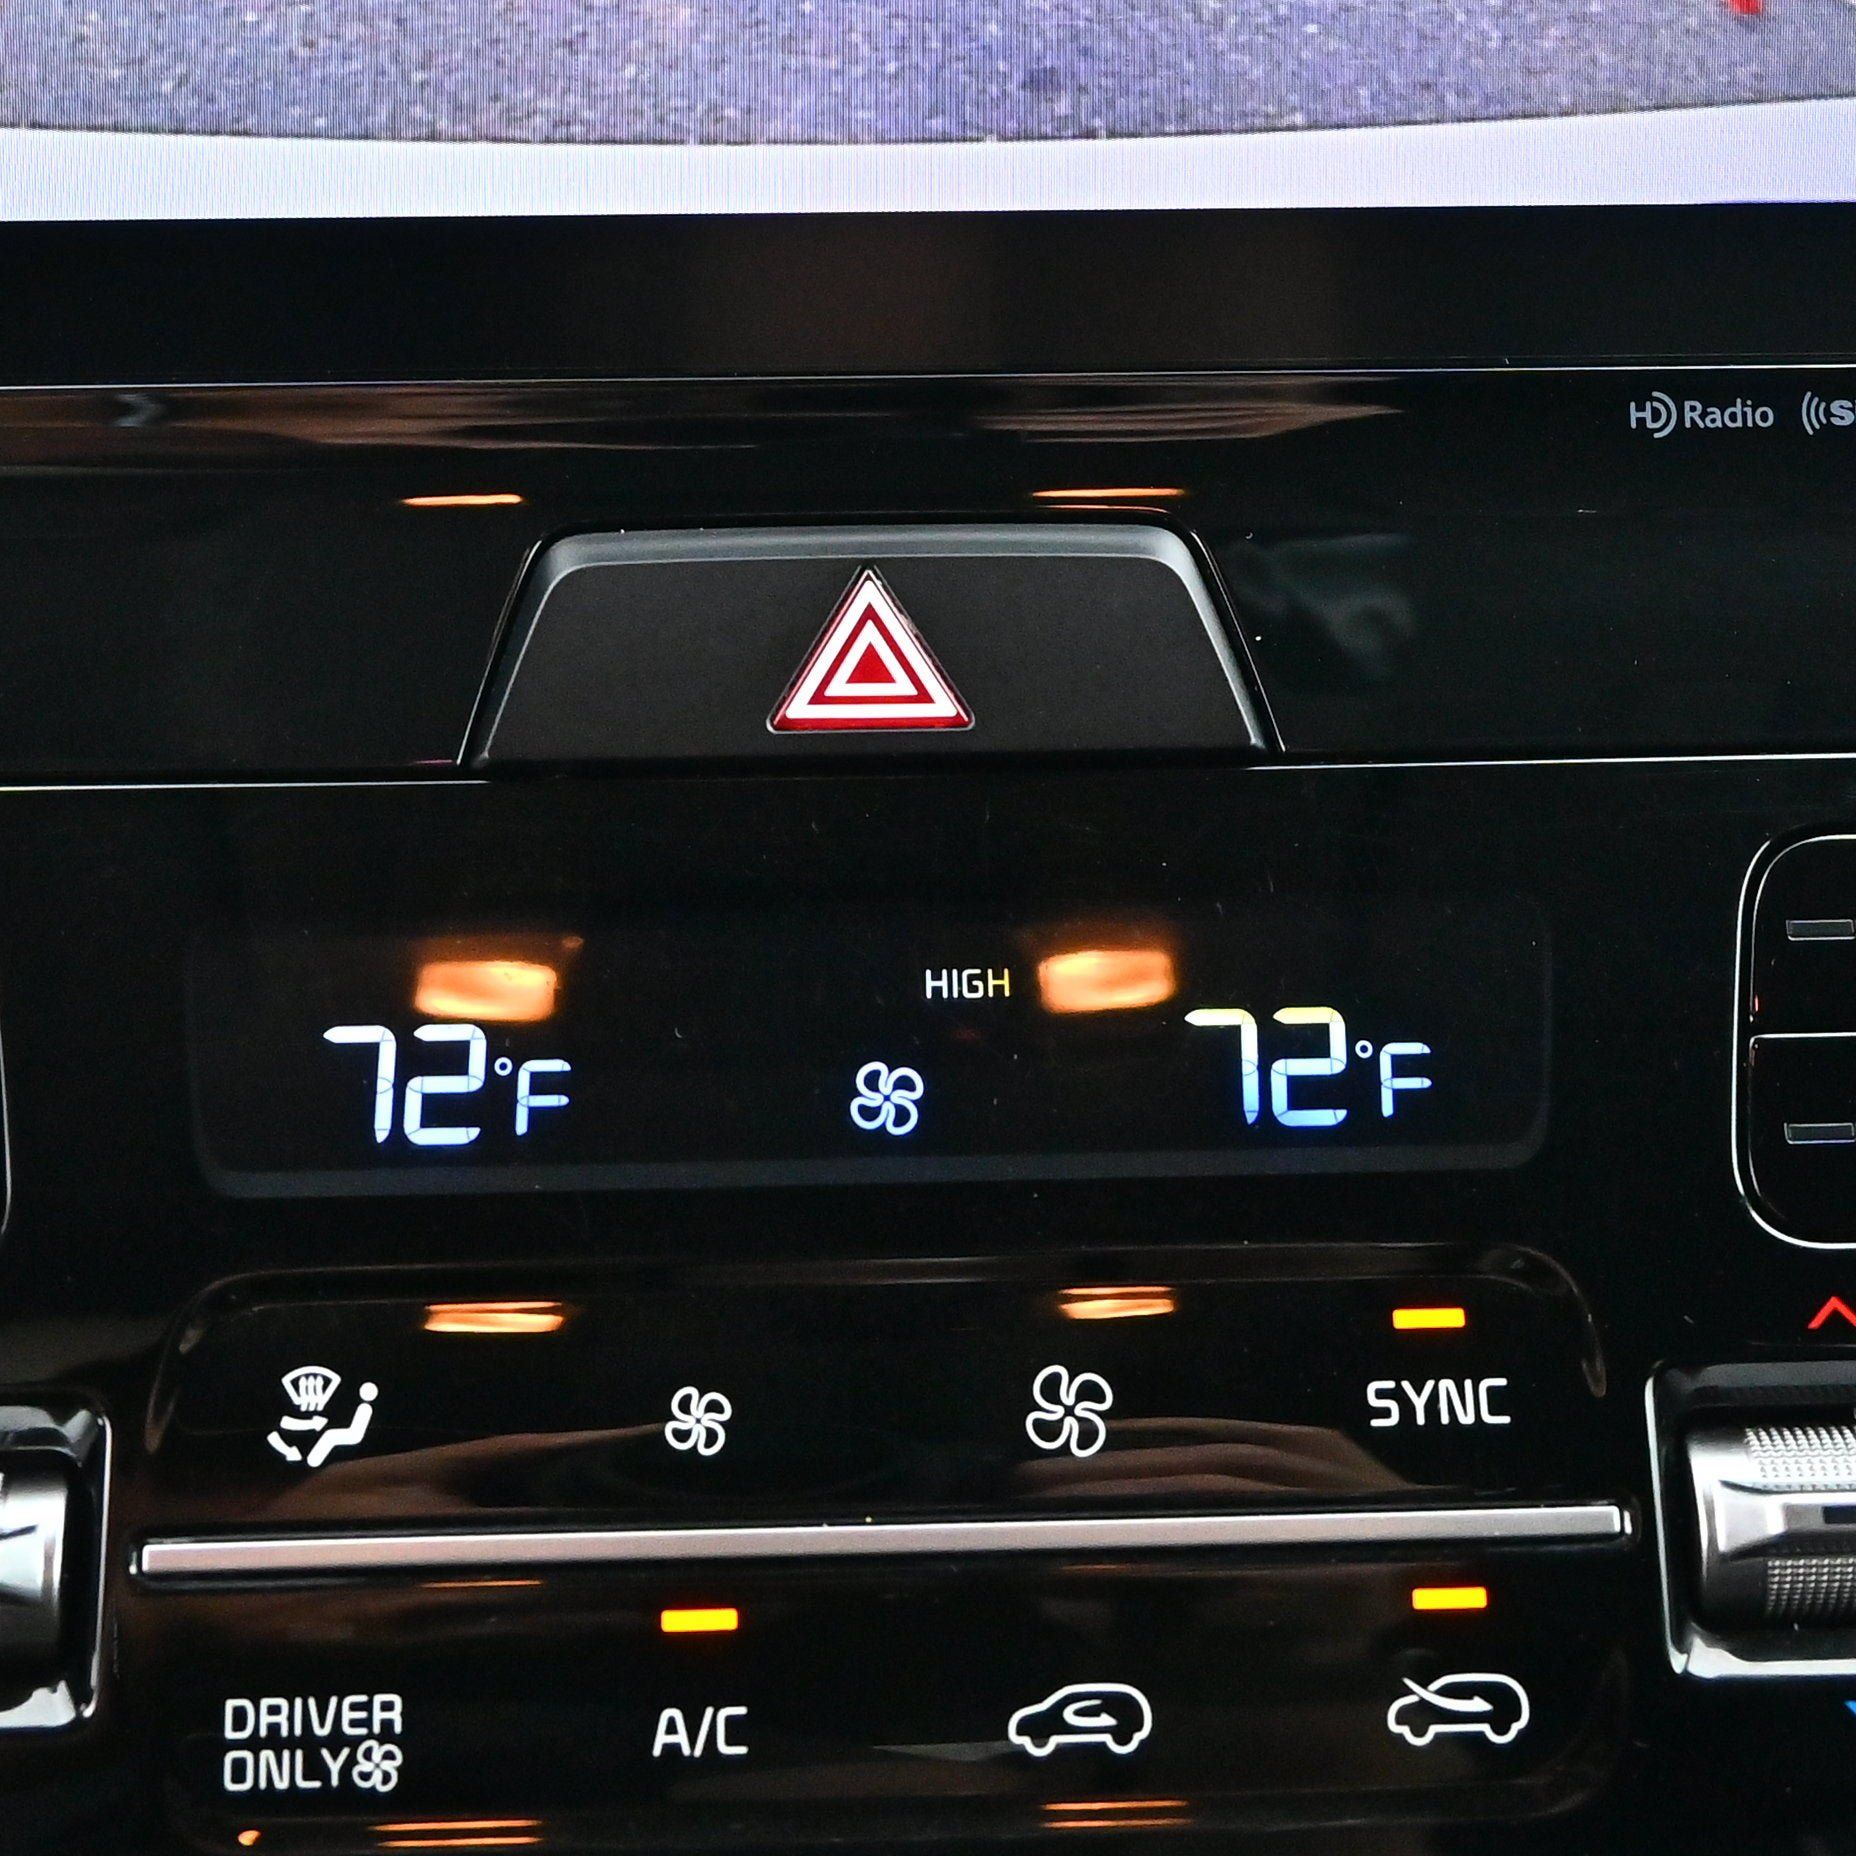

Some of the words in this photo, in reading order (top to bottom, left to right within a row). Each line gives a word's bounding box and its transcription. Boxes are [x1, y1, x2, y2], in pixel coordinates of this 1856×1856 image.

[1630, 391, 1677, 439] HD
[1684, 397, 1774, 429] Radio
[925, 968, 1011, 999] HIGH
[1366, 1377, 1512, 1427] SYNC
[223, 1693, 403, 1741] DRIVER
[652, 1706, 749, 1757] A/C
[223, 1746, 351, 1792] ONLY
